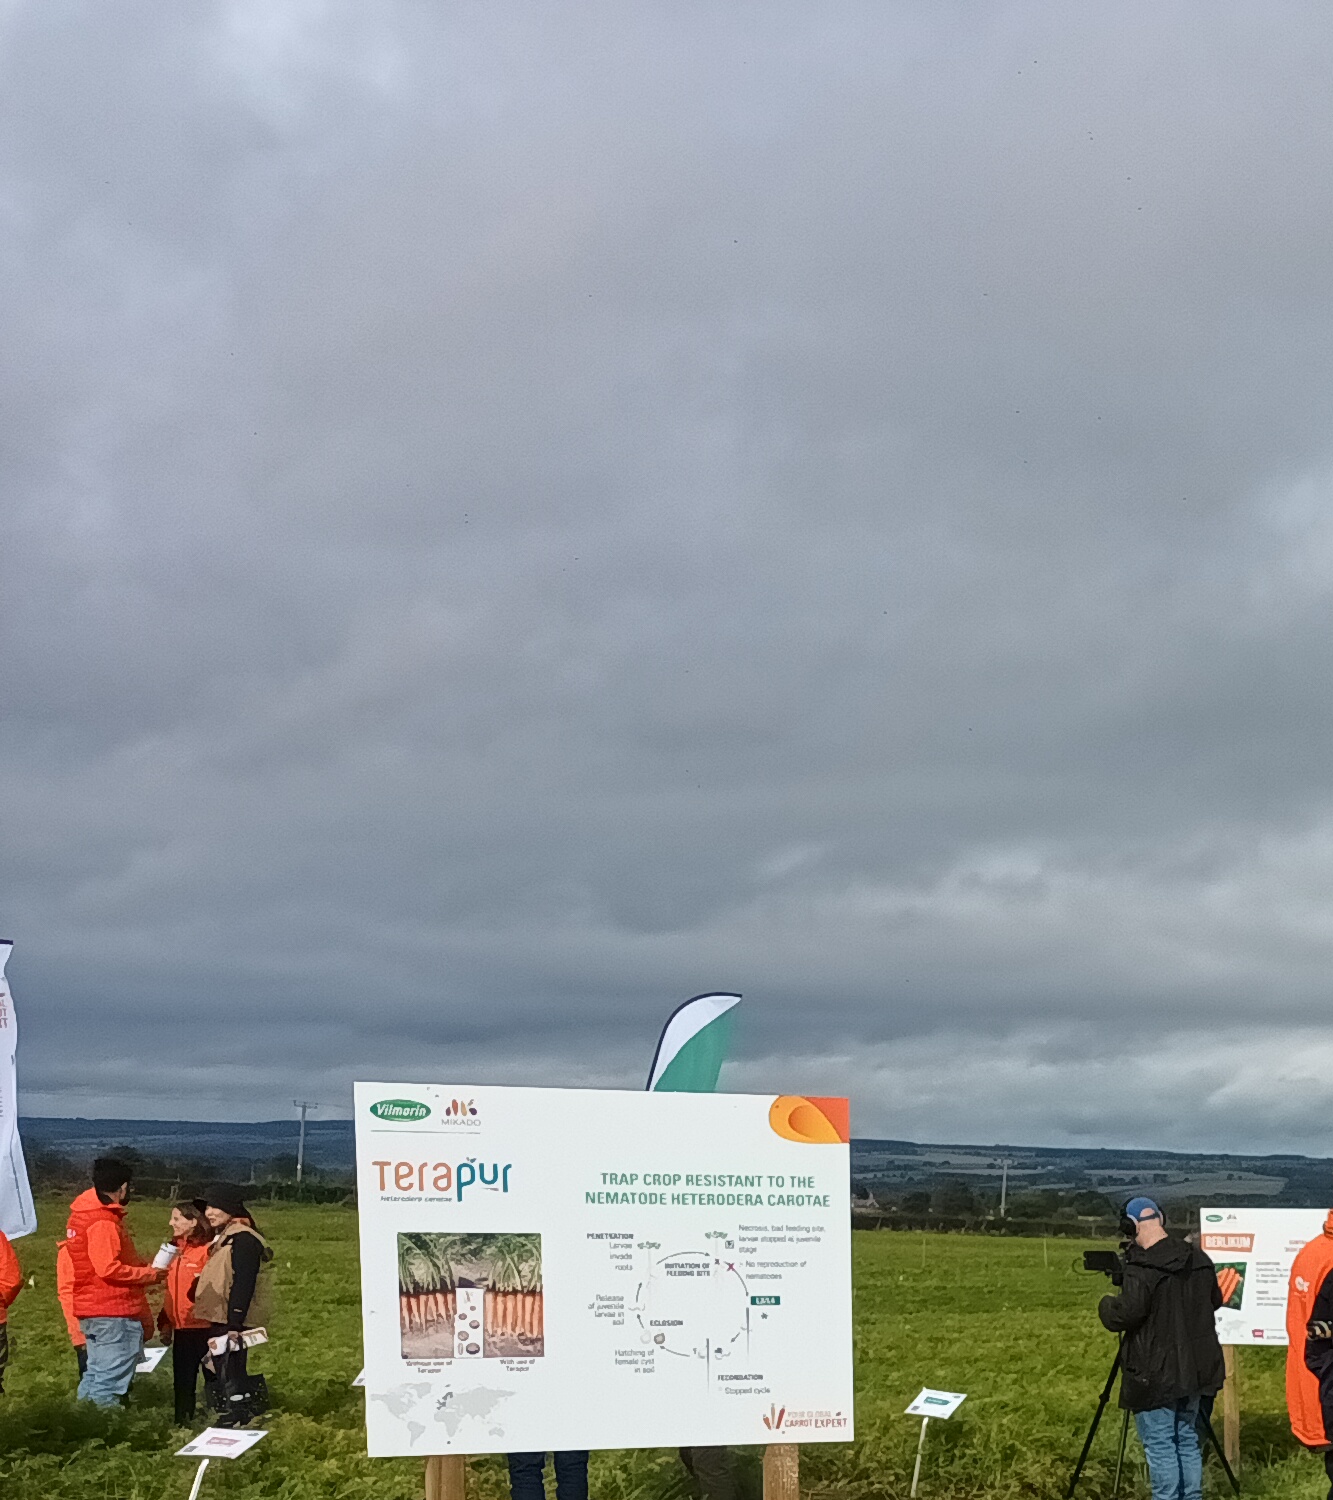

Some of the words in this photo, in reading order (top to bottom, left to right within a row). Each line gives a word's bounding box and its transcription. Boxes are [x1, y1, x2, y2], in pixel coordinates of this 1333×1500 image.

[376, 1103, 427, 1117] Vilmorin
[441, 1118, 481, 1126] MIKADO
[601, 1172, 639, 1186] TRAP
[643, 1174, 681, 1186] CROP
[686, 1175, 762, 1187] RESISTANT
[767, 1176, 784, 1187] TO
[790, 1176, 815, 1188] THE
[585, 1192, 667, 1205] NEMATODE
[671, 1192, 763, 1206] HETERODERA
[767, 1194, 830, 1207] CAROTAE
[785, 1419, 812, 1427] CARROT
[814, 1418, 847, 1428] EXPERT
